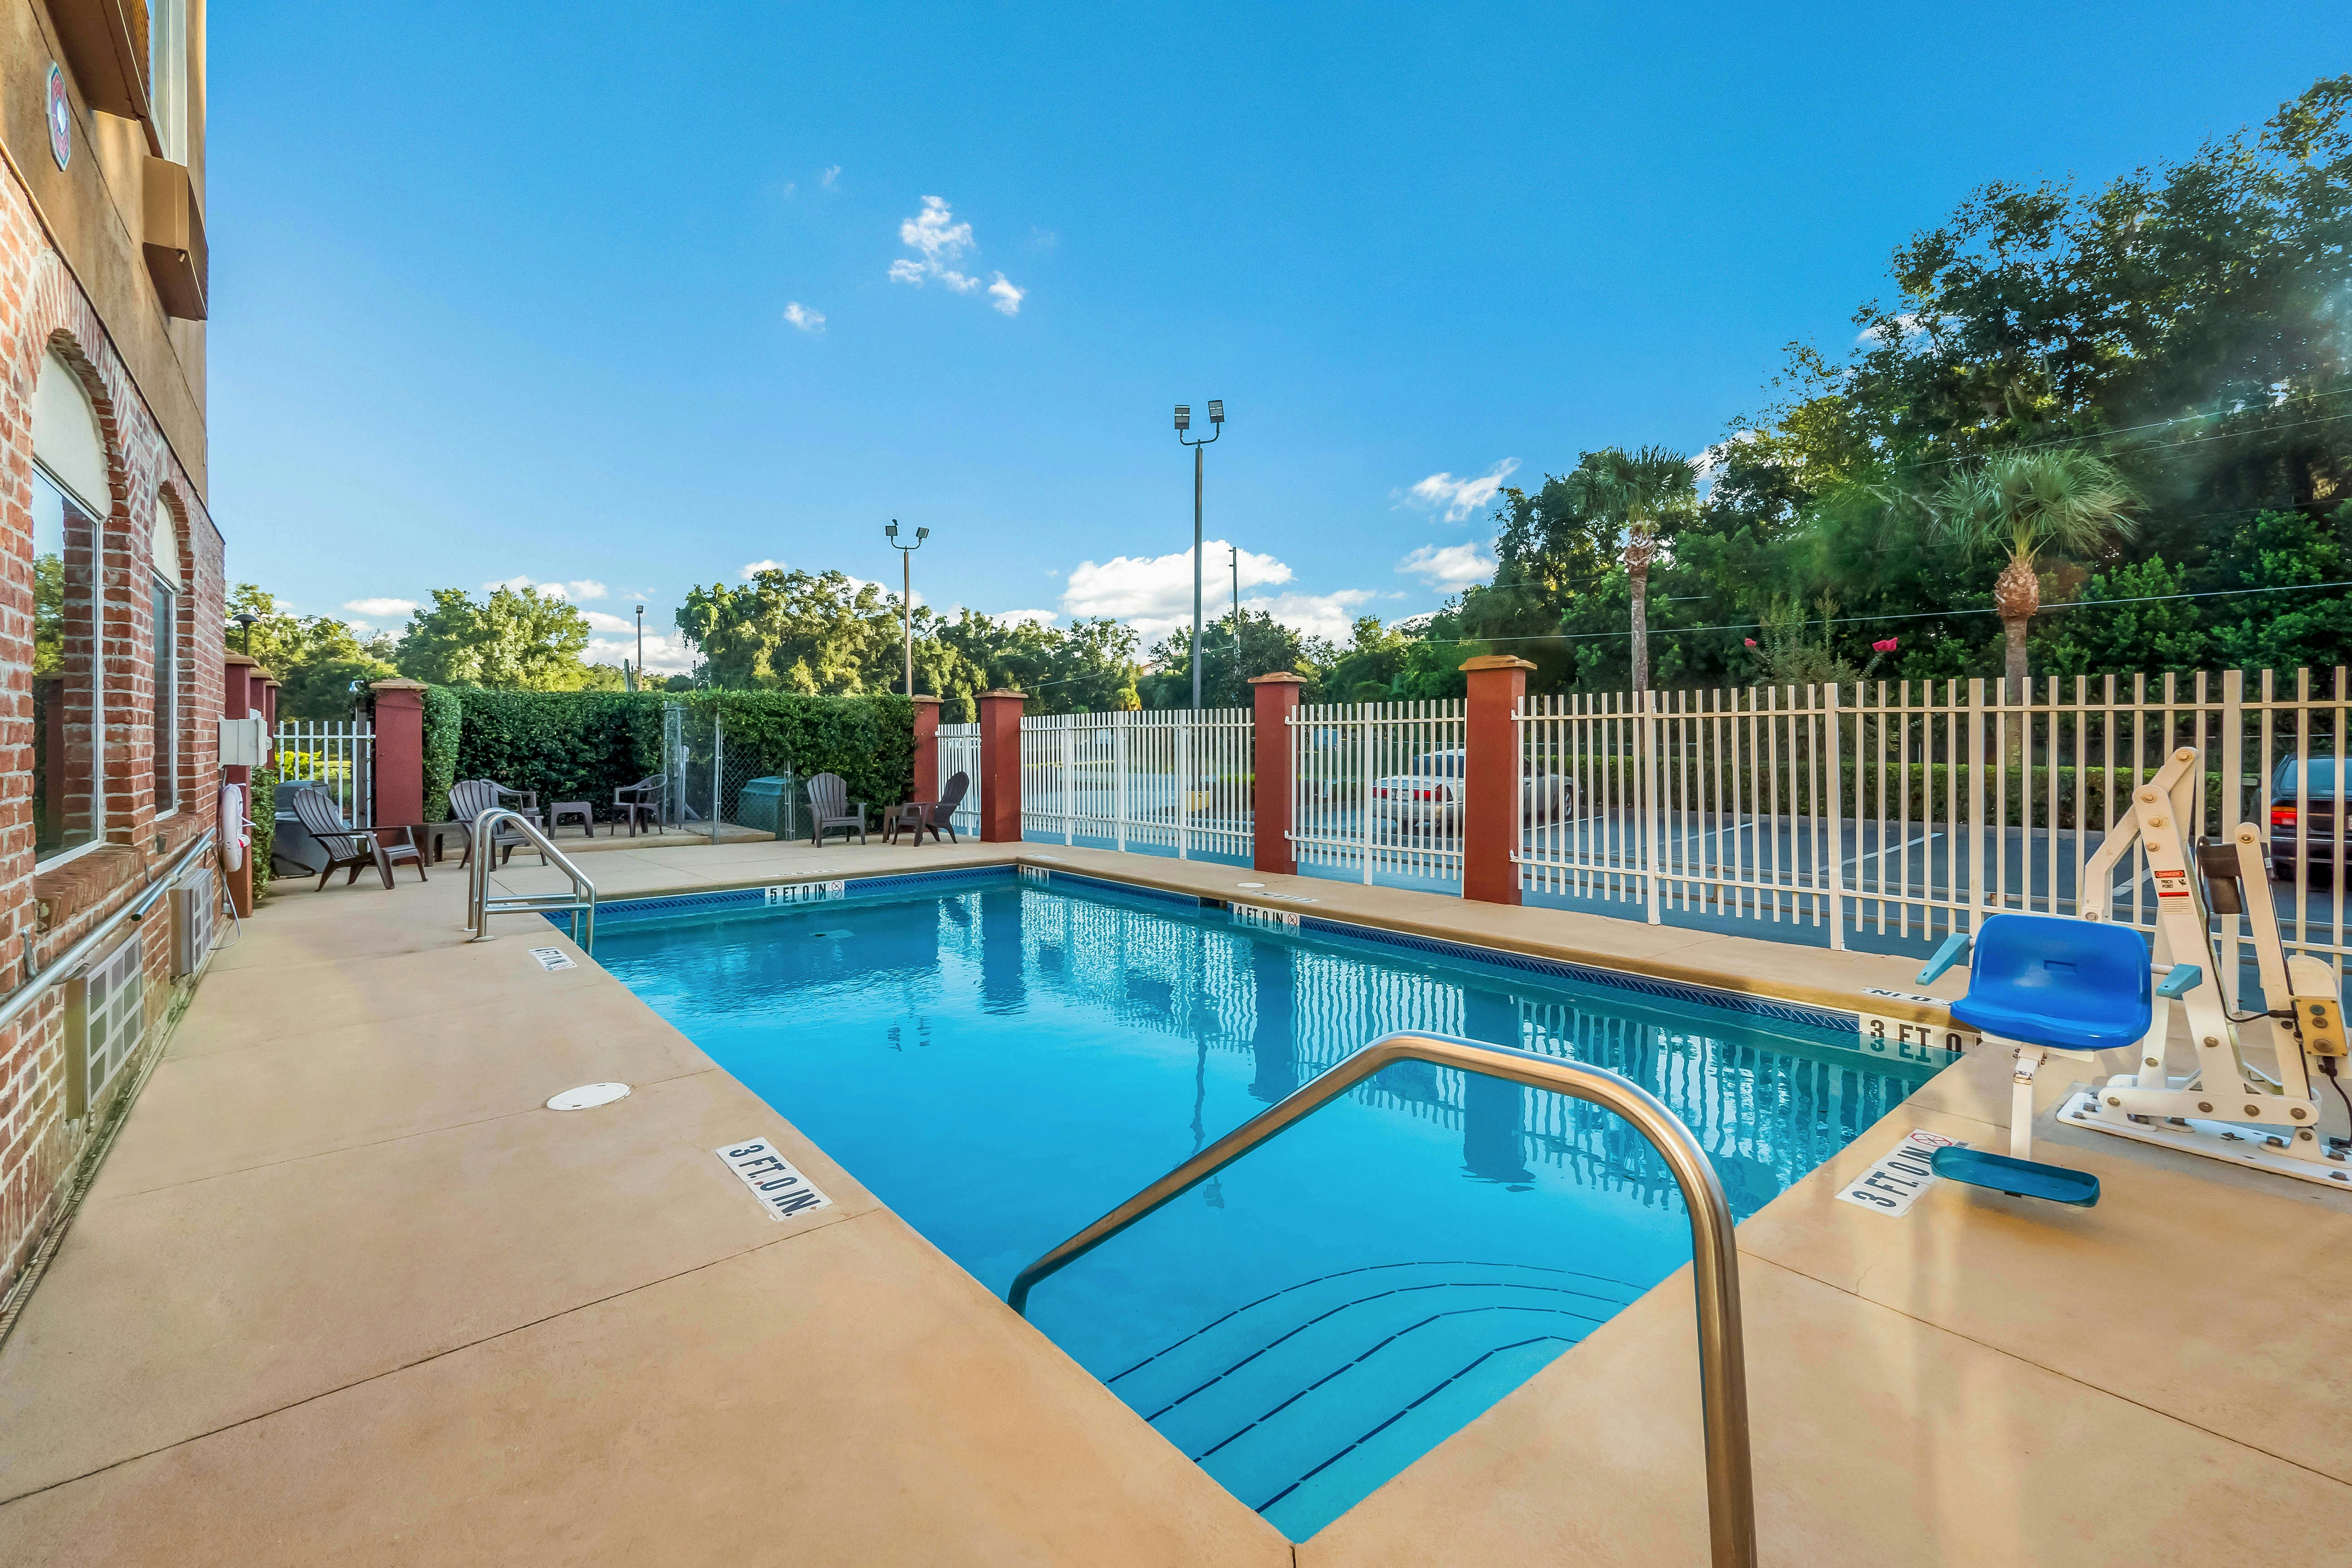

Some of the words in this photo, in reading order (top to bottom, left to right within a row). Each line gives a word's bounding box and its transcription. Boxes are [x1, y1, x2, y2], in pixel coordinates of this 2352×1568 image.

[1237, 906, 1243, 916] 4
[1870, 1019, 1885, 1038] 3
[729, 1144, 765, 1157] 3
[771, 1188, 822, 1217] IN.
[1852, 1190, 1897, 1208] 3
